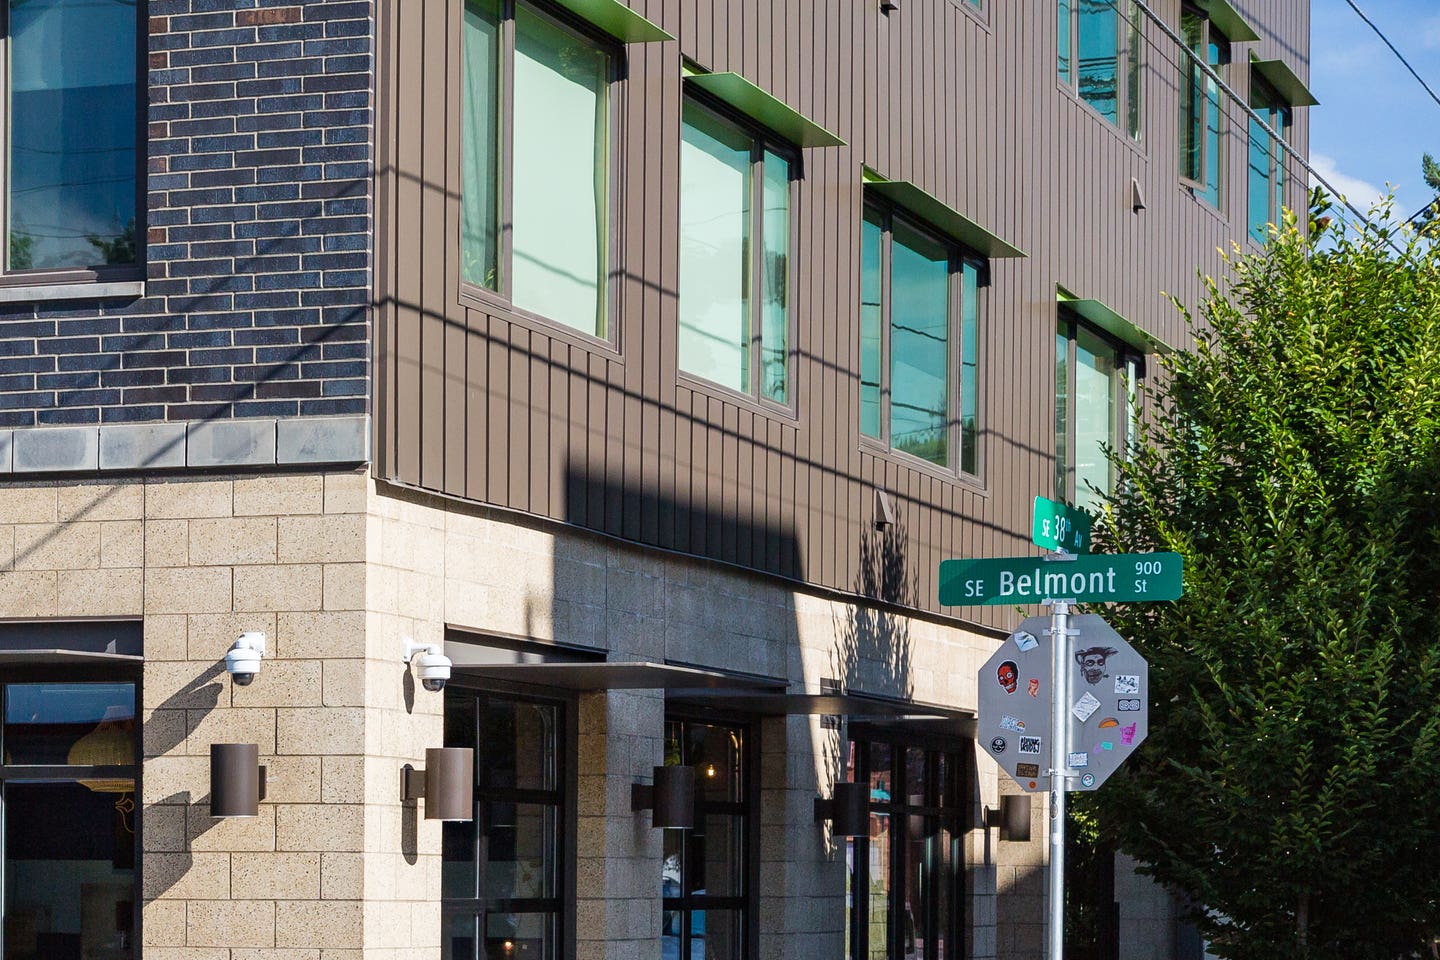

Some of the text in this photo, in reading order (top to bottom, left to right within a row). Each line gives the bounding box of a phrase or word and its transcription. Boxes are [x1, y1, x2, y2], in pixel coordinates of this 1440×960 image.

[1042, 518, 1051, 538] SE
[1135, 561, 1162, 575] 900
[964, 567, 1147, 597] SE Belmont St
